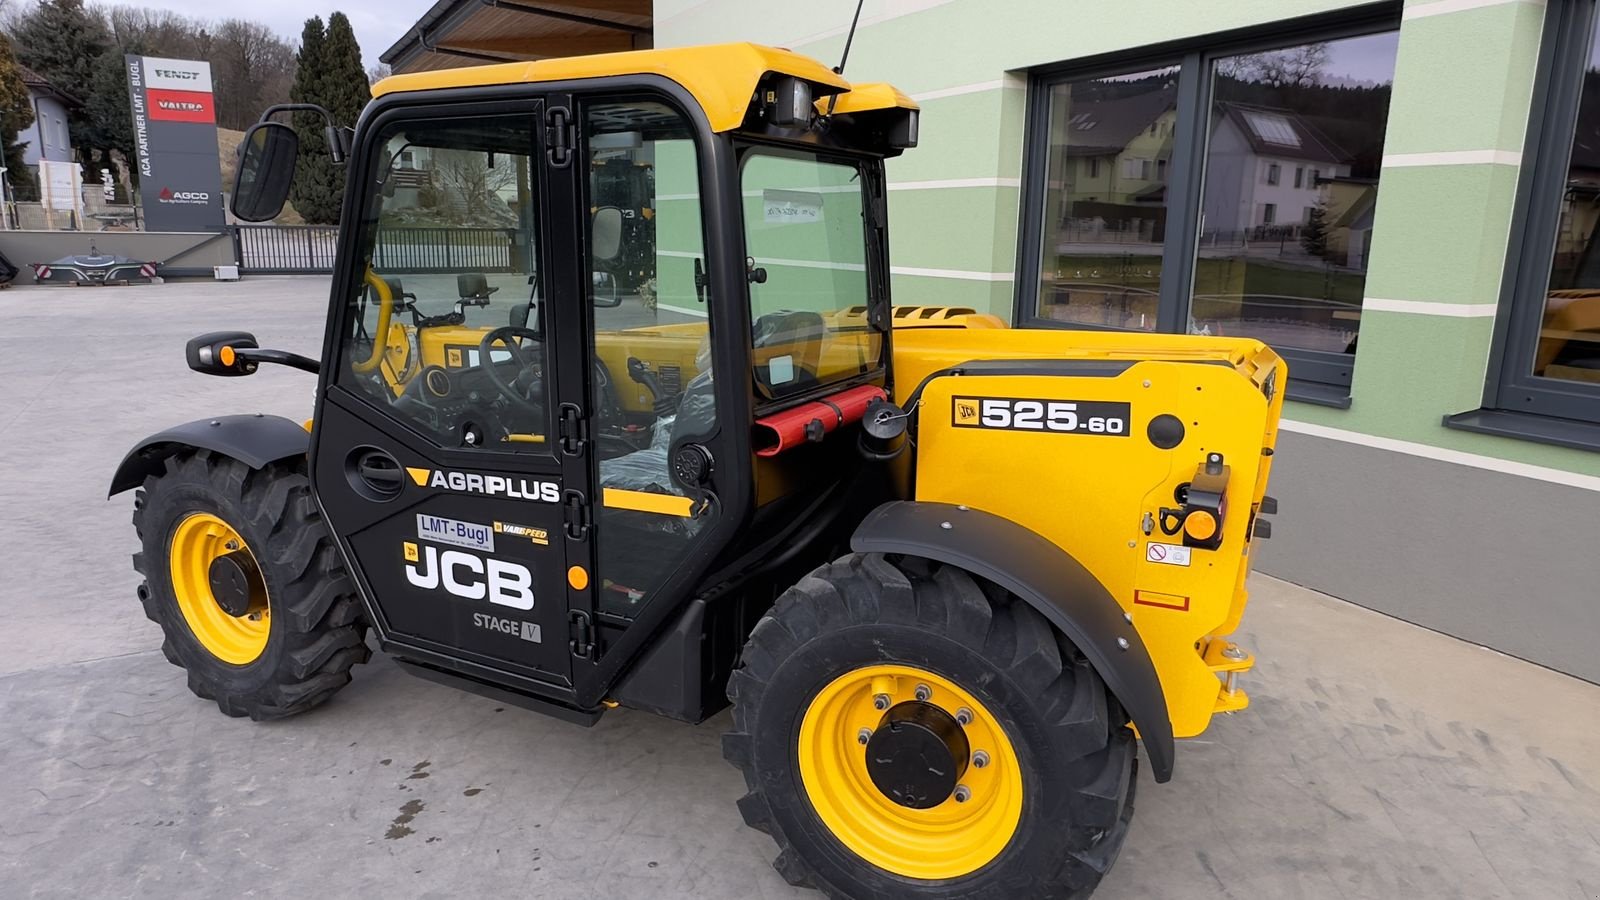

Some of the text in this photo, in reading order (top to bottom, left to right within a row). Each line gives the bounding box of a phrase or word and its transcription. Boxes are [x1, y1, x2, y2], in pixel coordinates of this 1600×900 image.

[129, 61, 141, 87] BUGL
[155, 69, 200, 80] FENDT
[133, 93, 144, 113] LMT
[158, 100, 204, 112] VALTRA
[136, 115, 149, 156] PARTNER
[141, 158, 152, 177] ACA
[173, 191, 209, 200] AGCO
[982, 399, 1124, 434] 525-60
[421, 515, 489, 545] LMT-Bugl
[405, 545, 535, 611] JCB
[473, 612, 537, 639] STAGE V
